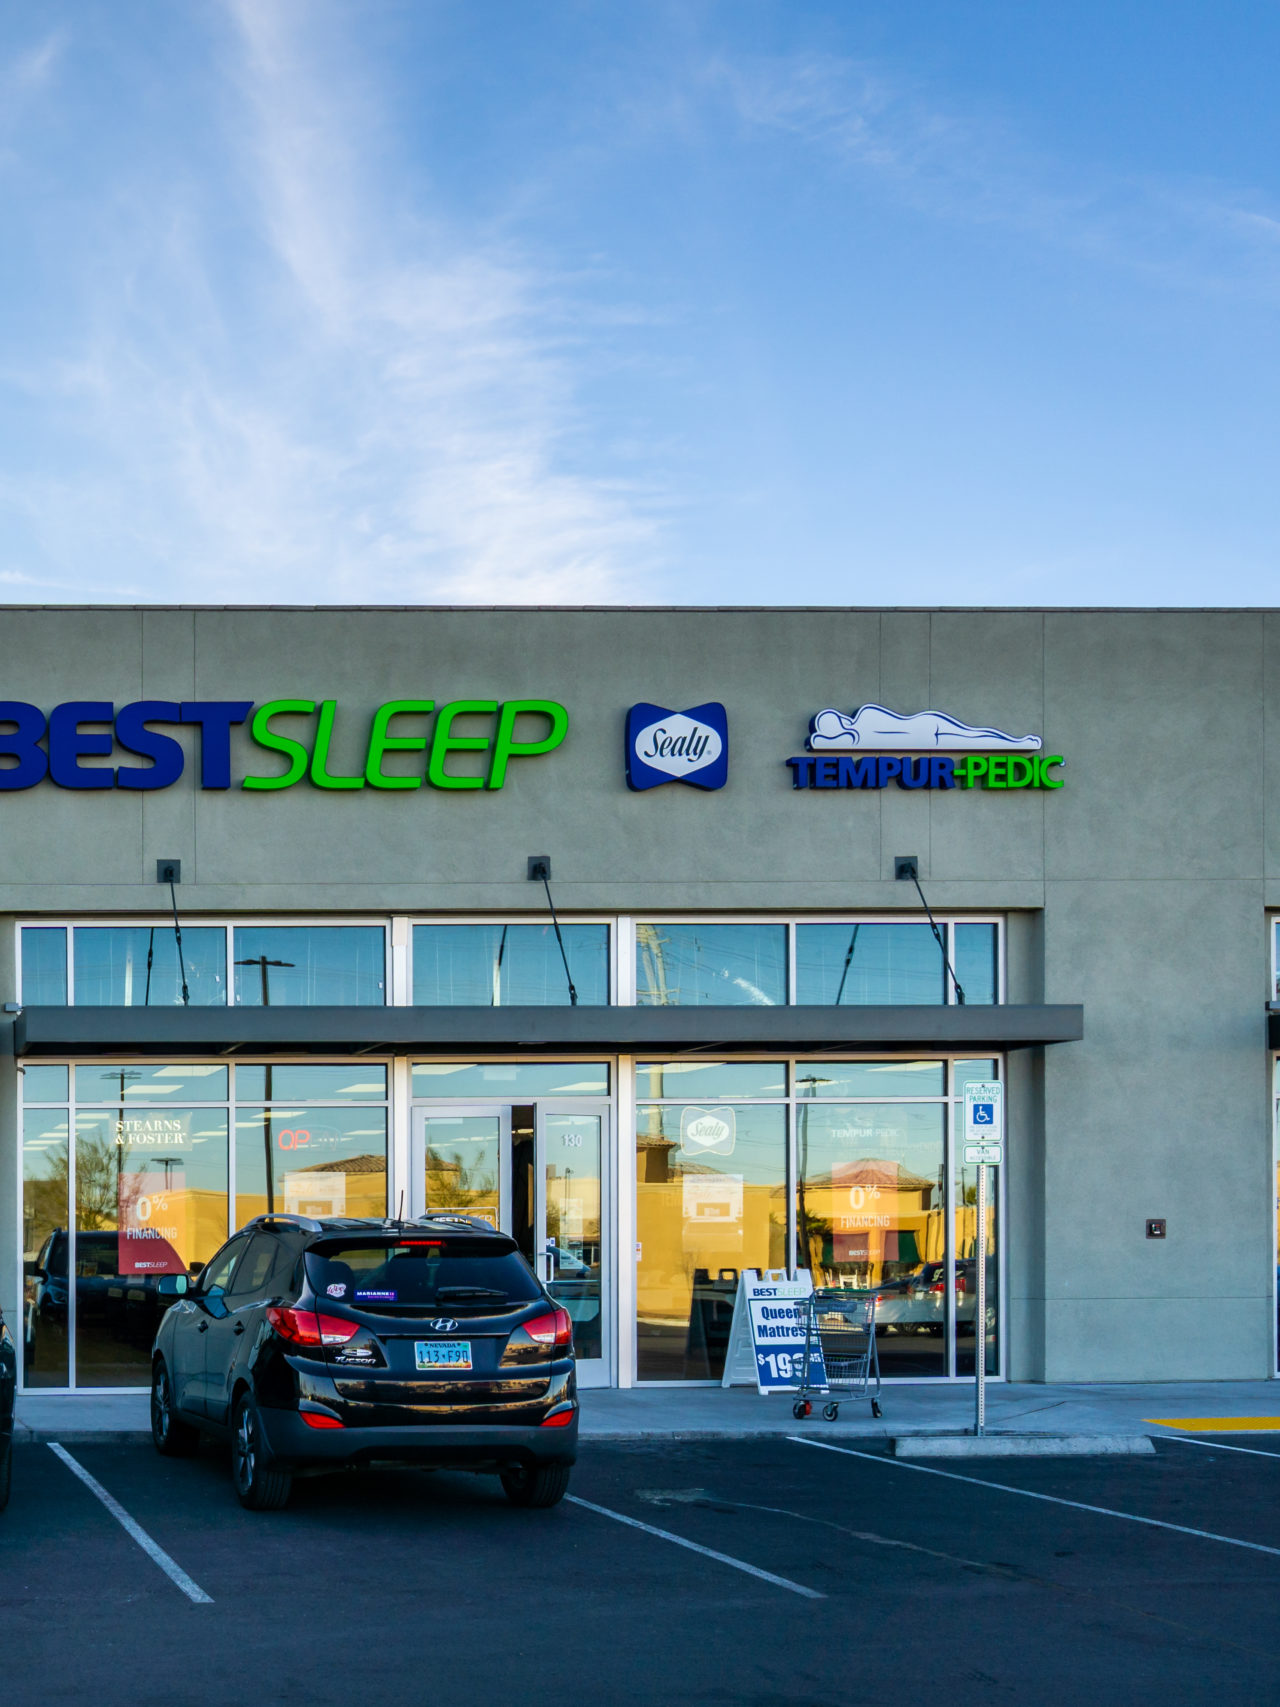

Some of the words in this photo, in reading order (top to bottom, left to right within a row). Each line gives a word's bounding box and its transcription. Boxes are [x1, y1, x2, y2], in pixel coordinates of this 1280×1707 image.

[644, 727, 709, 762] Sealy
[786, 755, 1065, 789] TEMPUR-PEDIC
[966, 1086, 1000, 1095] RESERVED
[969, 1095, 998, 1104] PARKING
[115, 1120, 182, 1132] STEARNS
[691, 1121, 726, 1141] Sealy
[115, 1133, 125, 1145] &
[128, 1133, 185, 1145] FOSTER
[562, 1134, 583, 1147] 130
[136, 1195, 169, 1221] 0%
[840, 1215, 891, 1229] FINANCING
[127, 1228, 178, 1240] FINANCING
[753, 1287, 807, 1297] BESTSLEEP
[761, 1306, 802, 1320] Queen
[757, 1325, 814, 1338] Mattres
